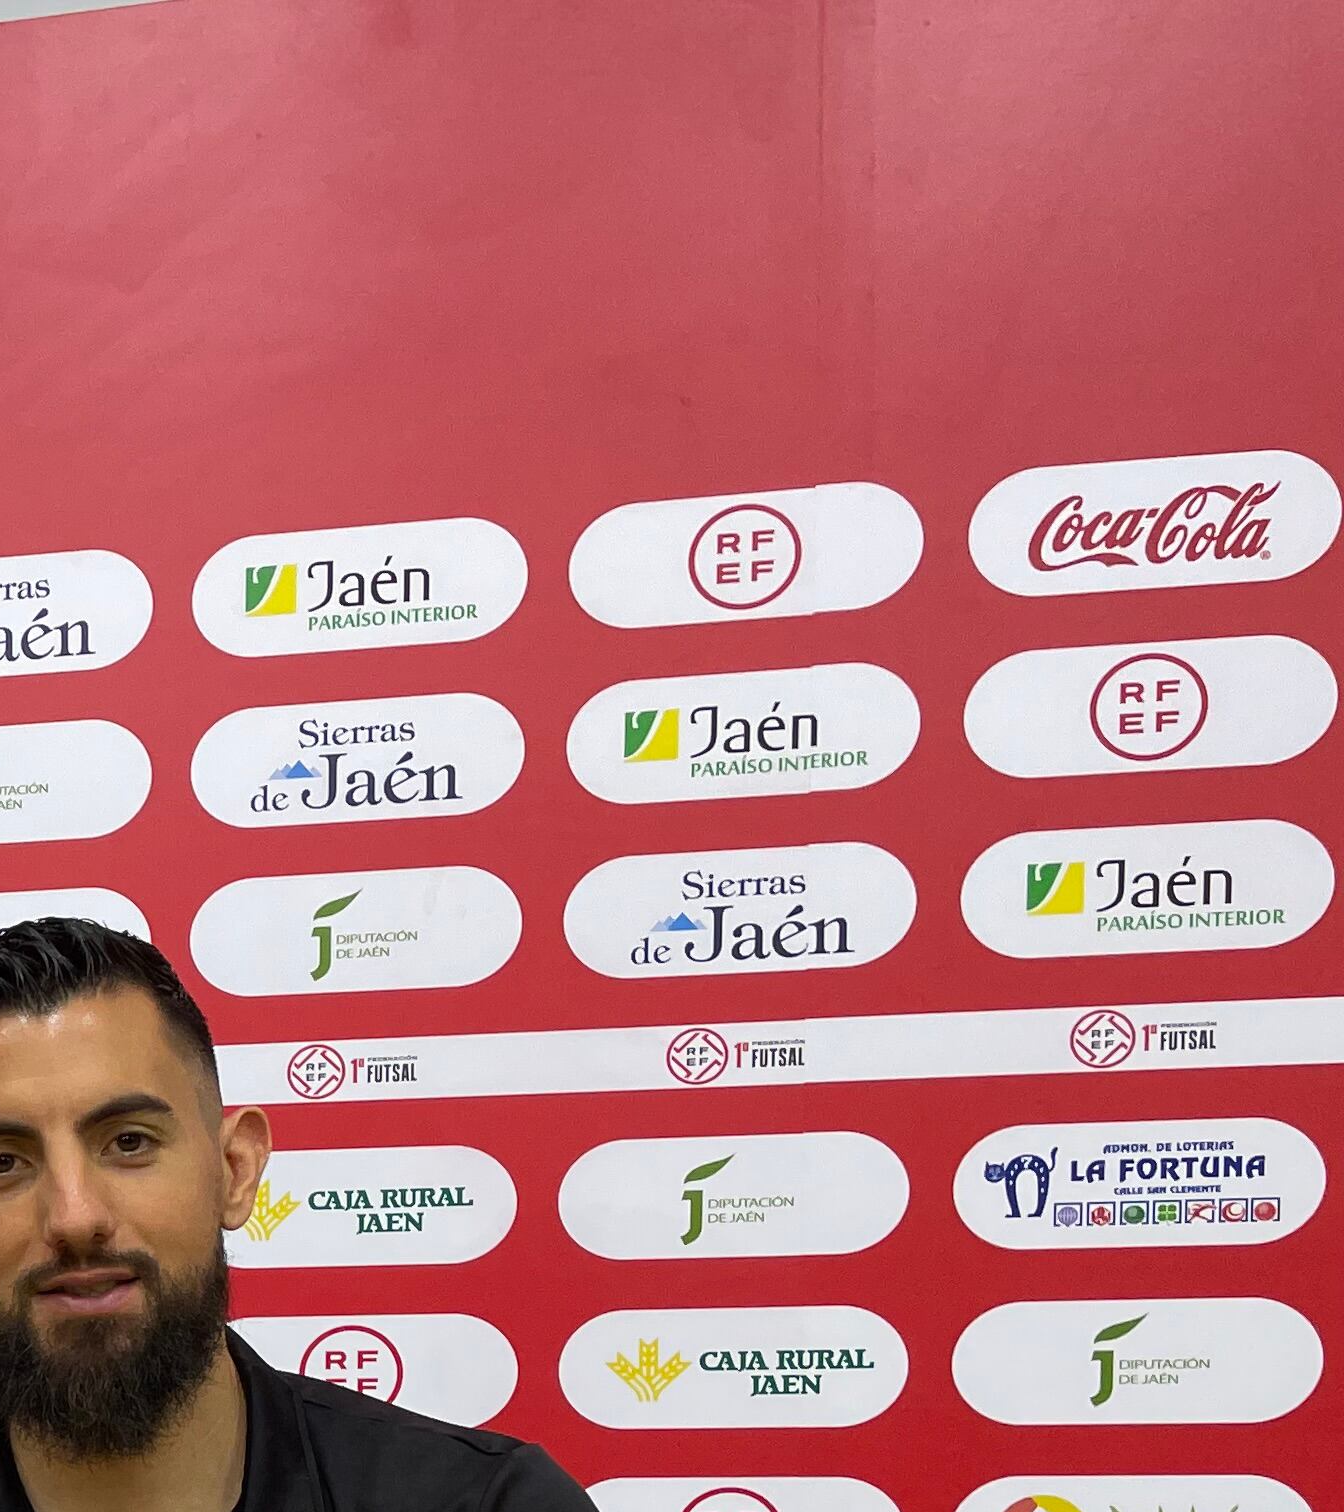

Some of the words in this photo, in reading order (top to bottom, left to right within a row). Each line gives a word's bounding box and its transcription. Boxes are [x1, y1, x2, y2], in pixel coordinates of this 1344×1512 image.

[1028, 481, 1281, 571] Coca-Cola
[308, 556, 429, 612] Jaén
[309, 608, 385, 630] PARAÍSO
[392, 604, 477, 624] INTERIOR
[299, 720, 415, 749] Sierras
[691, 702, 817, 758] Jaén
[692, 759, 772, 777] PARAÍSO
[779, 751, 867, 771] INTERIOR
[251, 788, 288, 812] de
[302, 752, 462, 809] Jaén
[682, 871, 805, 900] Sierras
[1097, 856, 1232, 912] Jaén
[1098, 911, 1182, 931] PARAÍSO
[1190, 909, 1285, 927] INTERIOR
[337, 930, 417, 944] DIPUTACIÓN
[631, 938, 670, 964] de
[684, 905, 854, 962] Jaén
[336, 949, 353, 959] DE
[357, 946, 389, 958] JAÉN
[1161, 1030, 1216, 1050] FUTSAL
[1157, 1143, 1171, 1152] DE
[1071, 1160, 1105, 1183] LA
[1120, 1155, 1265, 1182] FORTUNA
[308, 1190, 373, 1211] CAJA
[381, 1187, 473, 1208] RURAL
[1170, 1185, 1221, 1193] CLEMENTE
[708, 1196, 794, 1208] DIPUTACIÓN
[357, 1213, 424, 1234] JAEN
[708, 1213, 725, 1223] DE
[730, 1211, 764, 1223] JAÉN
[700, 1351, 769, 1372] CAJA
[776, 1349, 874, 1369] RURAL
[1120, 1358, 1210, 1369] DIPUTACIÓN
[751, 1375, 822, 1396] JAEN
[1119, 1375, 1138, 1384] DE
[1142, 1373, 1178, 1384] JAÉN
